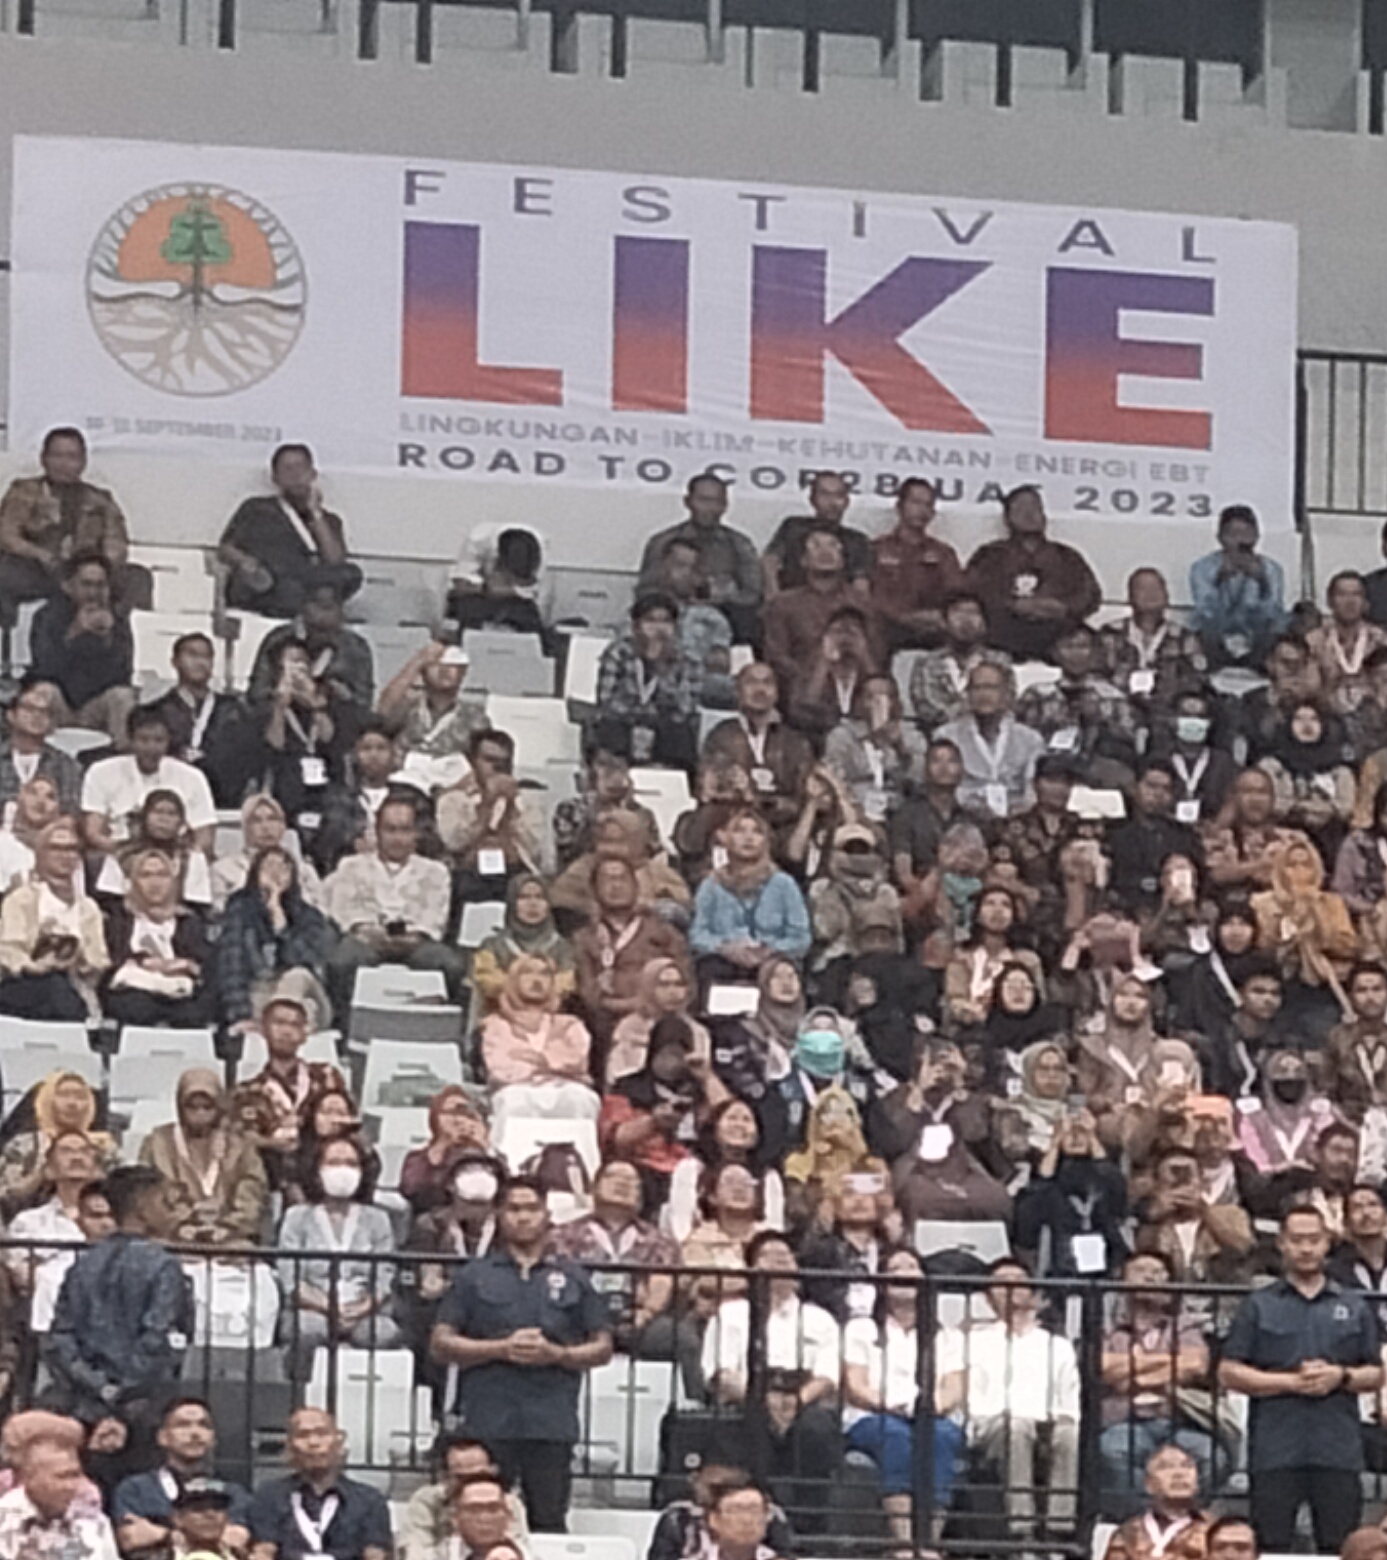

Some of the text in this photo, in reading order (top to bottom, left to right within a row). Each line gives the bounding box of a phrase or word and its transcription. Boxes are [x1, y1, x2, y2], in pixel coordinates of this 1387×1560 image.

[403, 169, 1216, 264] FESTIVAL
[400, 220, 1216, 452] LIKE
[398, 443, 567, 476] ROAD
[598, 454, 673, 483] TO
[931, 477, 1043, 505] UA
[1073, 486, 1213, 518] 2023
